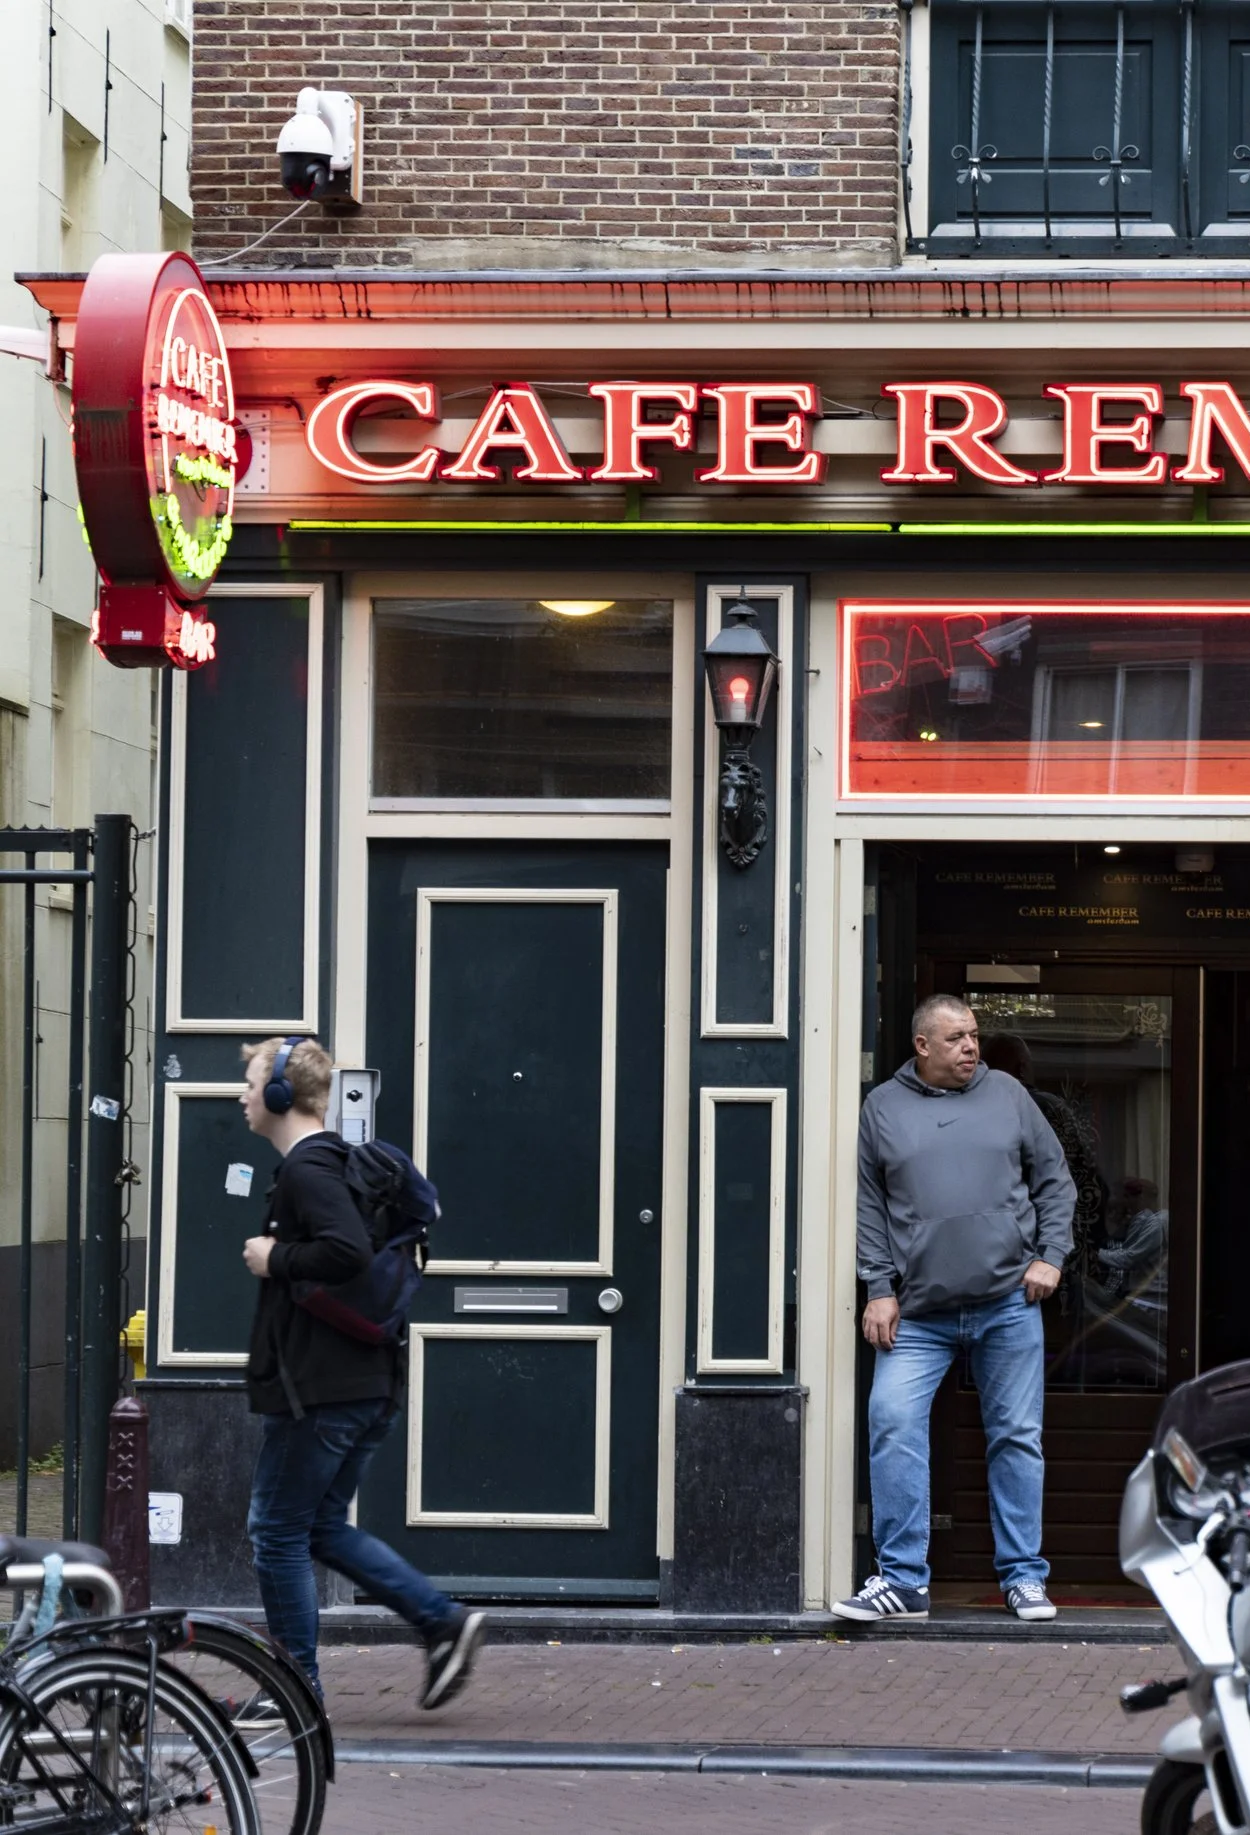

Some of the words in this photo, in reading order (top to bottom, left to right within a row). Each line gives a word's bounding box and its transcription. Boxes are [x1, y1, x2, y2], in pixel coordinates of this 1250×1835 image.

[171, 336, 225, 408] CAFE
[304, 380, 828, 484] CAFE
[179, 610, 216, 663] BAR
[851, 612, 998, 696] BAR
[935, 872, 972, 883] CAFE
[975, 872, 1056, 883] REMEMBER
[1103, 873, 1140, 884] CAFE
[1018, 906, 1055, 917] CAFE
[1058, 906, 1139, 918] REMEMBER
[1186, 908, 1222, 919] CAFE
[1086, 917, 1139, 925] amsterdam
